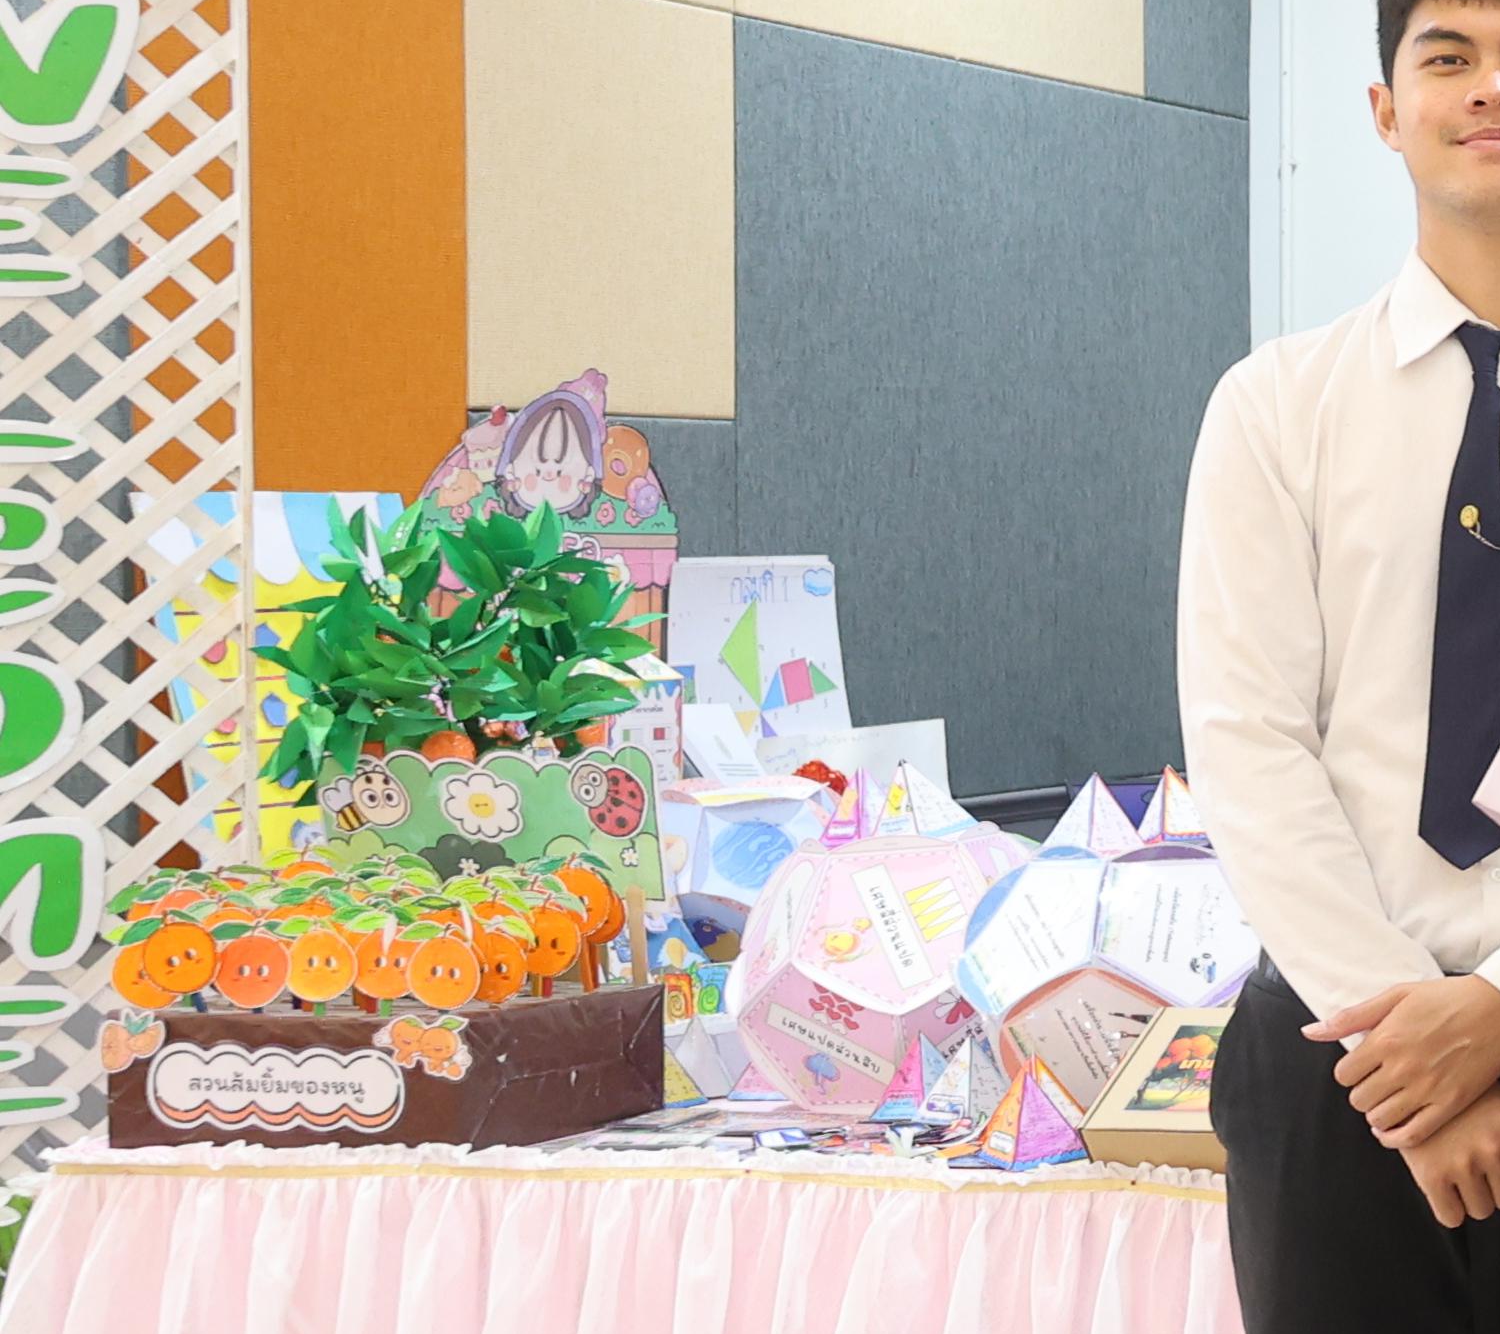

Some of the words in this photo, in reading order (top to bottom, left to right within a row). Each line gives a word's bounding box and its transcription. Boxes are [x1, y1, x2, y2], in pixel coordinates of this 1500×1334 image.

[188, 1068, 366, 1104] สวนส้มยิ้มของหนู
